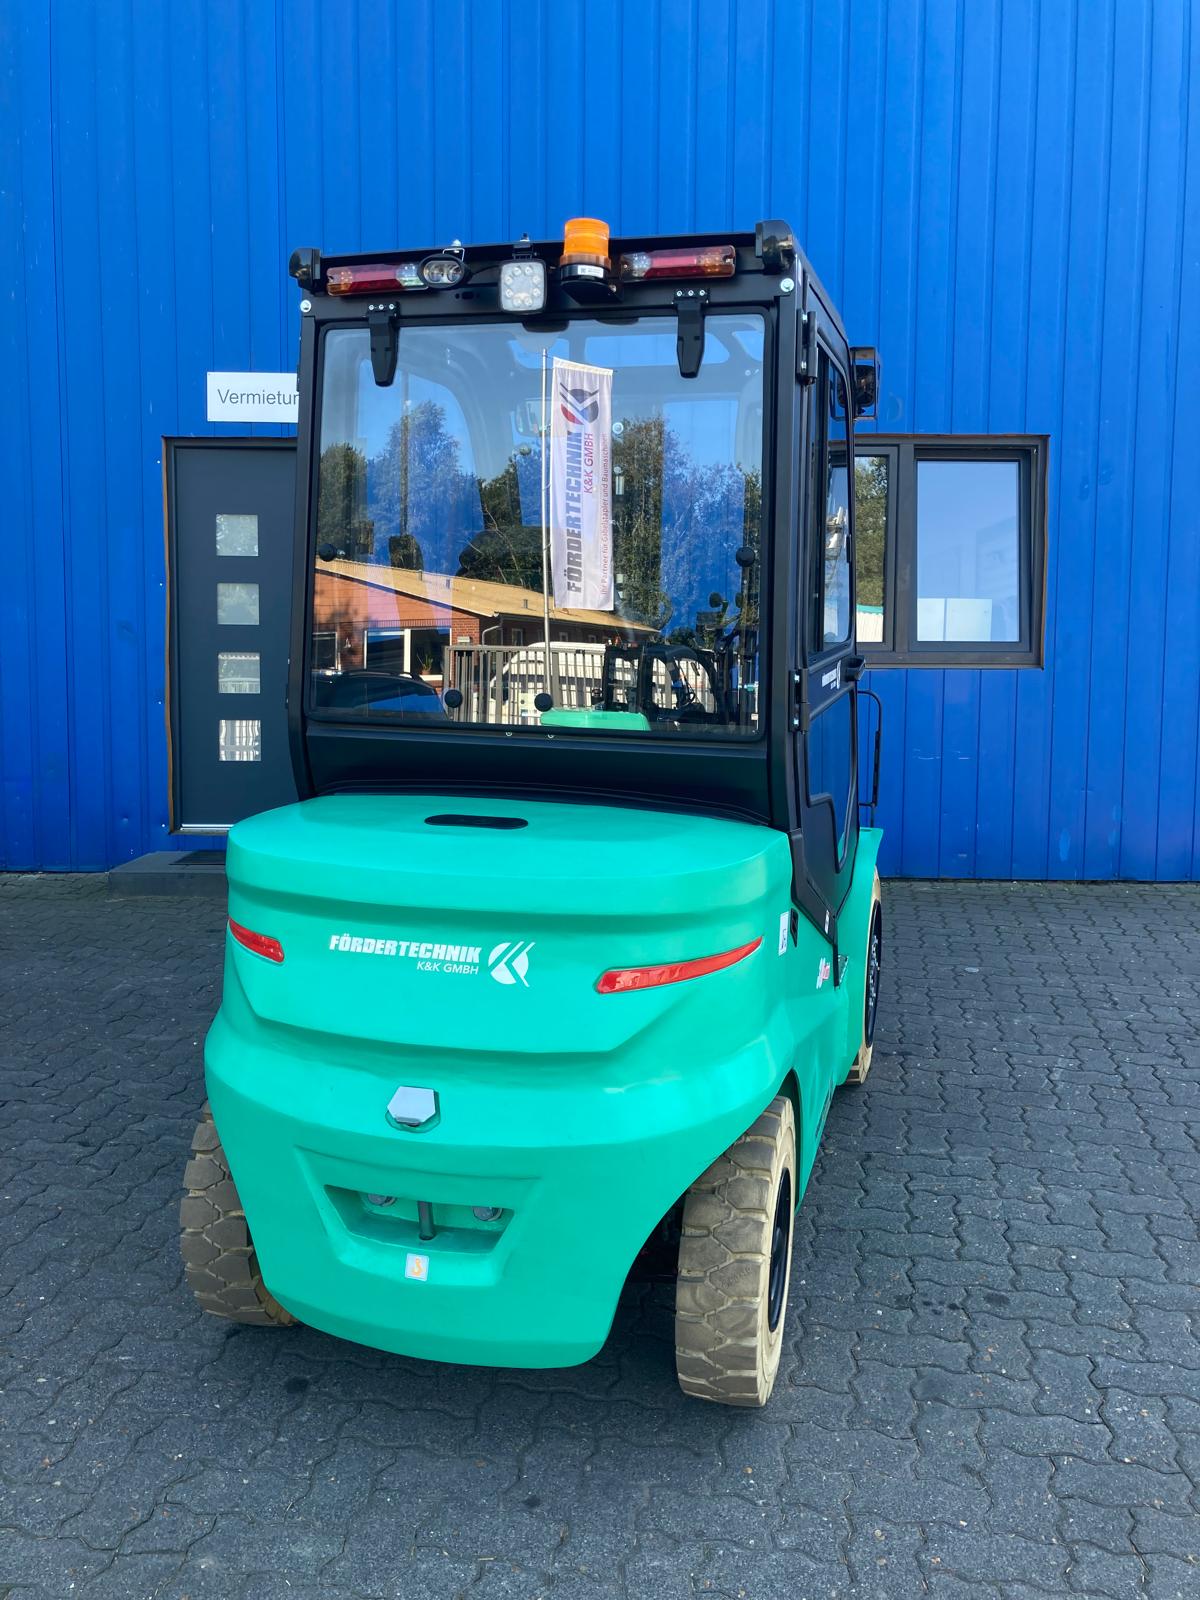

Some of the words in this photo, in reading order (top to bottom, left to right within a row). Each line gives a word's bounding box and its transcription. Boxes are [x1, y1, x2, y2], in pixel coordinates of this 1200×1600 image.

[583, 433, 593, 467] GMBH
[584, 470, 593, 494] K&K
[563, 430, 582, 593] FÖRDERTECHNIK
[600, 498, 609, 542] Gabelstapler
[329, 933, 482, 963] FÖRDERTECHNIK
[416, 961, 440, 973] K&K
[442, 963, 479, 975] GMBH
